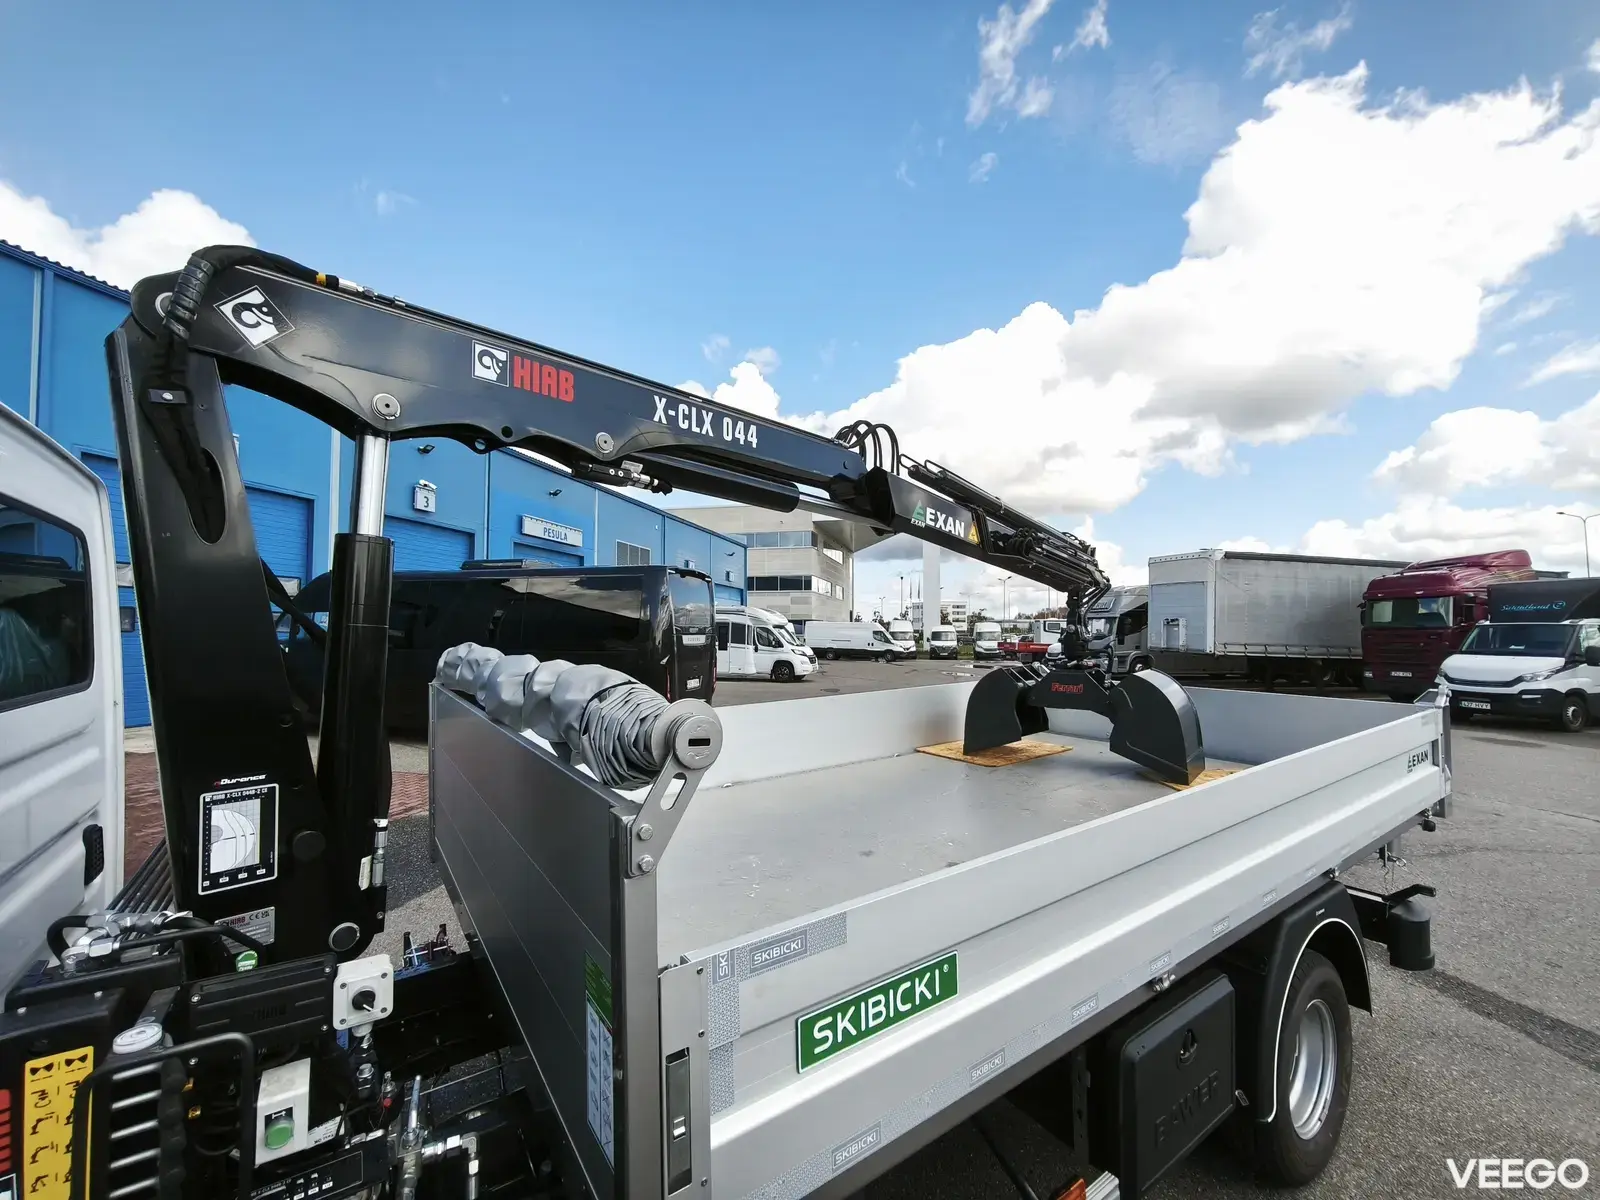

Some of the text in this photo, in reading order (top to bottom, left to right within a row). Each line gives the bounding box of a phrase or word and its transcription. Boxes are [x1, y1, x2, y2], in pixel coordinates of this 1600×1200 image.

[513, 355, 574, 402] HIAB
[653, 394, 758, 449] X-CLX 044
[423, 495, 430, 508] 3
[543, 526, 568, 542] PESULA
[910, 517, 926, 528] EXAN
[926, 506, 965, 538] EXAN
[1411, 749, 1429, 768] EXAN
[753, 938, 802, 965] SKIBICKI
[812, 968, 941, 1055] SKIBICKI
[971, 1055, 1003, 1081] SKIBICKI
[835, 1132, 877, 1165] SKIBICKI
